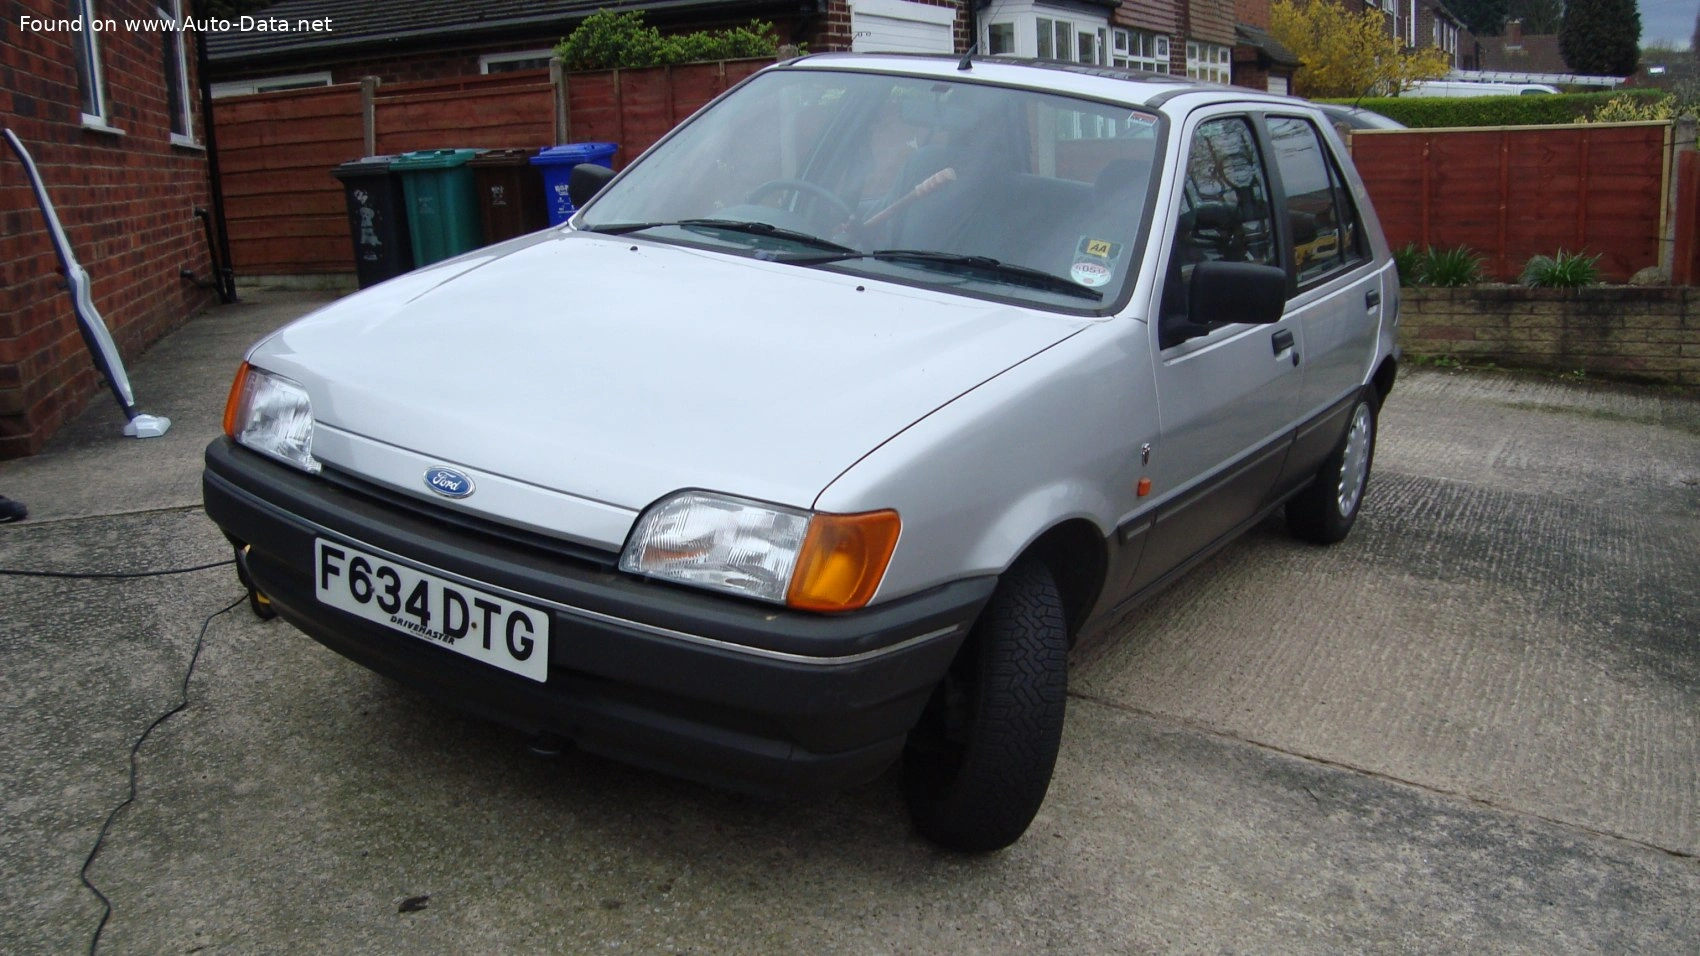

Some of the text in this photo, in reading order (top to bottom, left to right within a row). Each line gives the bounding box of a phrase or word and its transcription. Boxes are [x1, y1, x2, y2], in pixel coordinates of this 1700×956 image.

[1089, 244, 1107, 254] AA
[432, 471, 462, 491] Ford
[321, 544, 535, 662] F634 DTG
[390, 616, 456, 646] DRIVEMASTER
